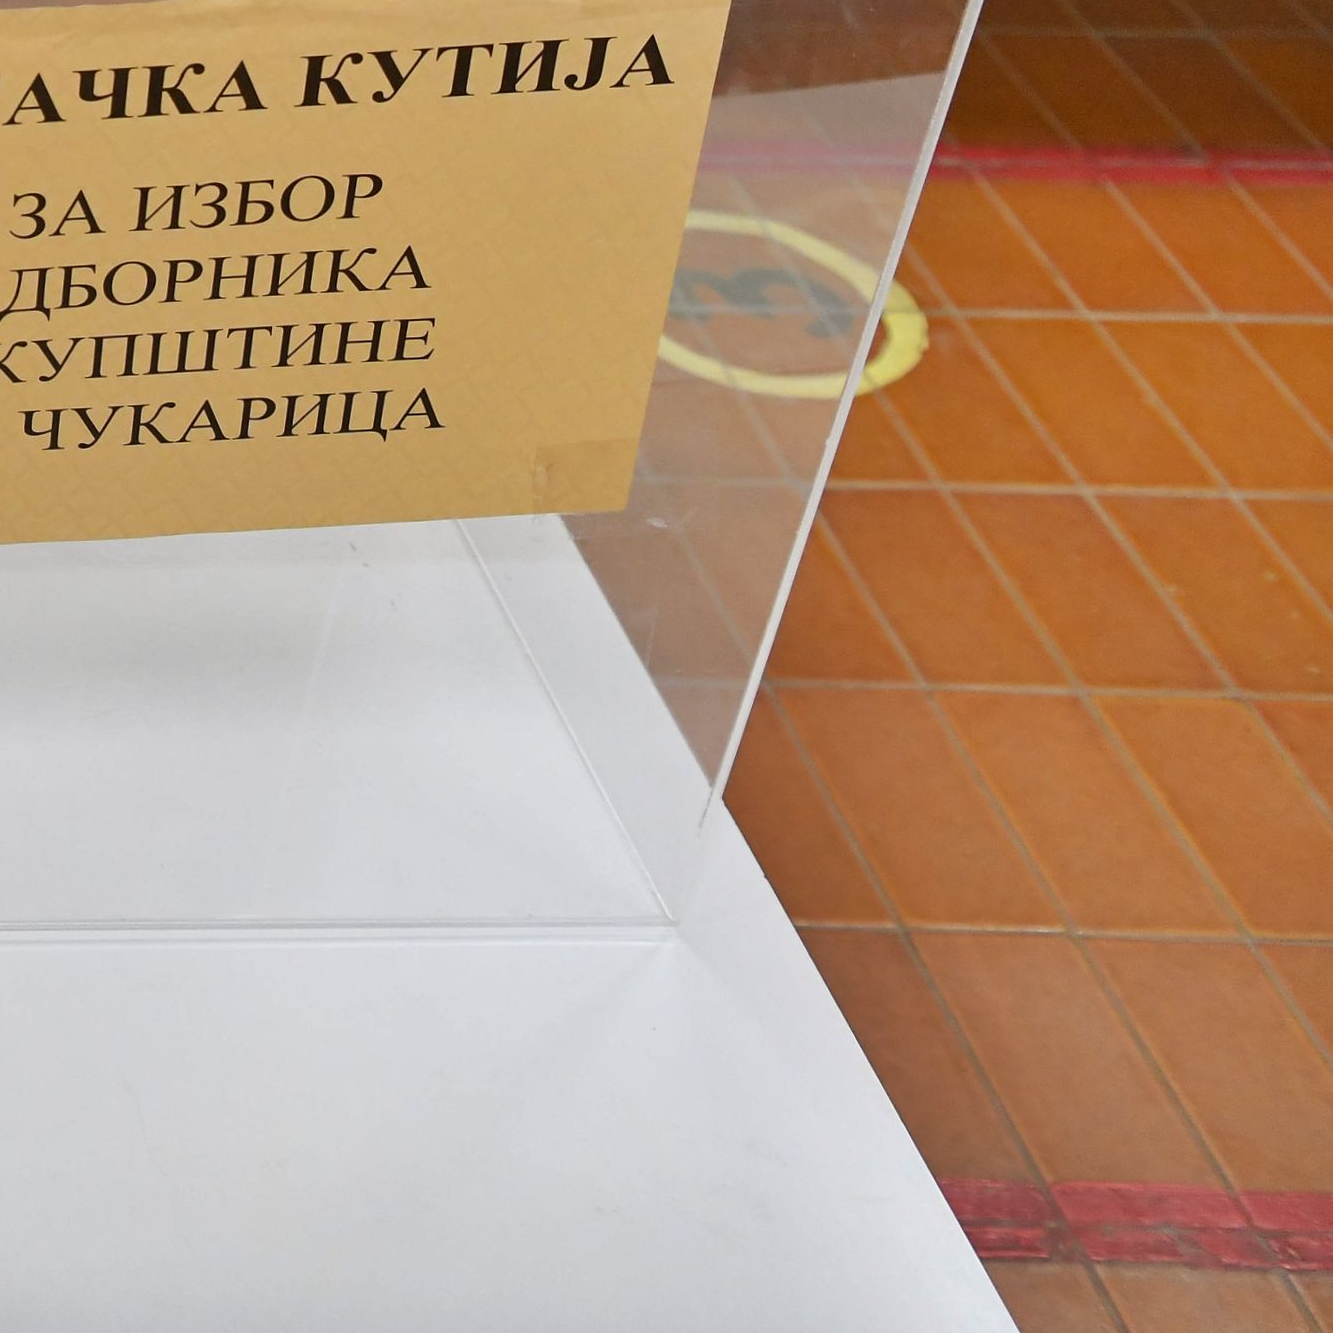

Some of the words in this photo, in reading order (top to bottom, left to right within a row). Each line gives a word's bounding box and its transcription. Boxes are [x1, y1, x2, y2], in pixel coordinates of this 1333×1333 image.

[295, 35, 674, 107] КУТИЈА
[10, 190, 105, 239] ЗА
[132, 174, 382, 231] ИЗБОР
[20, 388, 445, 451] ЧУКАРИЦА
